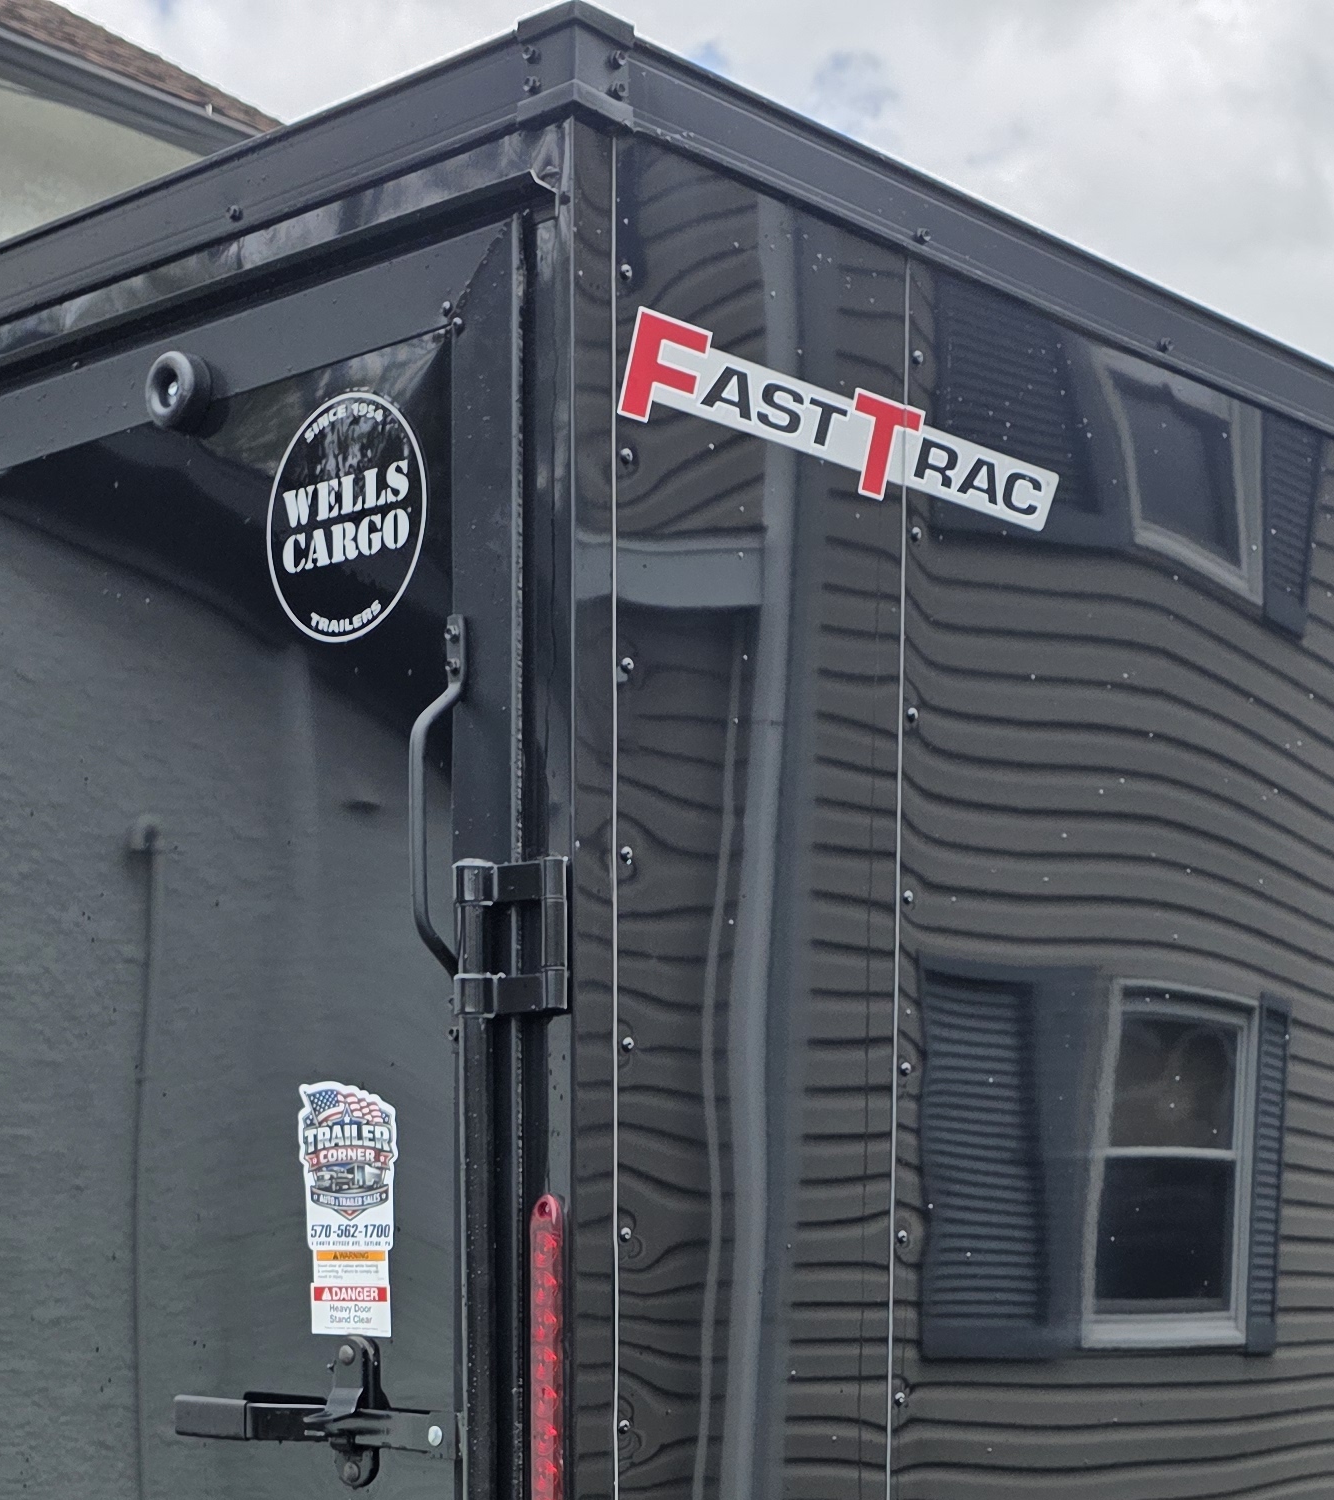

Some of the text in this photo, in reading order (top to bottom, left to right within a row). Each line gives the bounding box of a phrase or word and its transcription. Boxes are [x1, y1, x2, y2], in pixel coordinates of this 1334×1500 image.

[304, 402, 384, 443] SINCE 1954
[282, 459, 410, 528] WELLS
[282, 508, 410, 574] CARGO
[310, 599, 382, 633] TRAILERS
[304, 1124, 391, 1152] TRAILER
[319, 1149, 375, 1163] CORNER
[320, 1194, 335, 1205] AUTO
[339, 1196, 363, 1206] TRAILER
[311, 1224, 391, 1238] 570-562-1700
[338, 1251, 370, 1260] WARNING
[332, 1287, 379, 1301] DANGER
[330, 1304, 372, 1315] Heavy Door
[330, 1314, 373, 1324] Stand Clear
